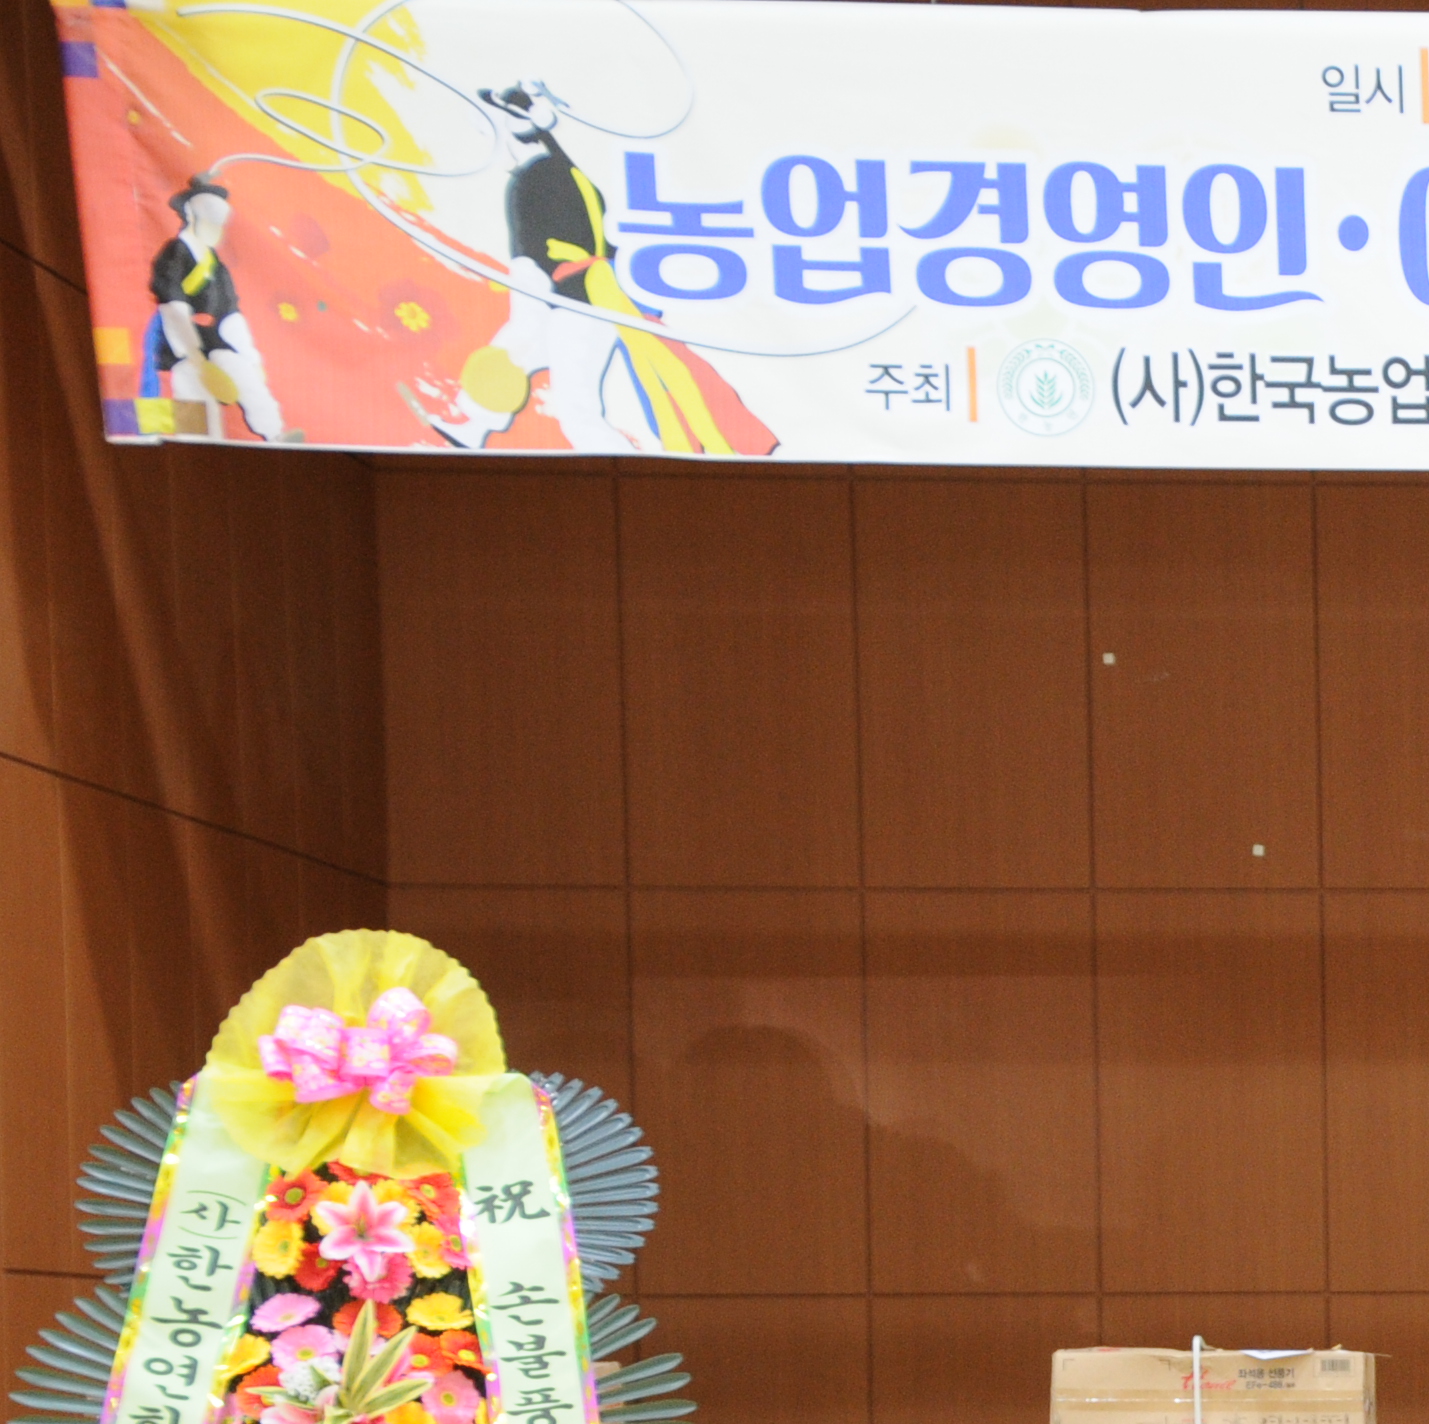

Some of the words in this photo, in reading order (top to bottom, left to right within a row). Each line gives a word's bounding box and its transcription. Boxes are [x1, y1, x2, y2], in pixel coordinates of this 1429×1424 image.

[1321, 63, 1406, 115] 일시
[863, 361, 952, 412] 주최
[473, 1179, 551, 1226] 祝
